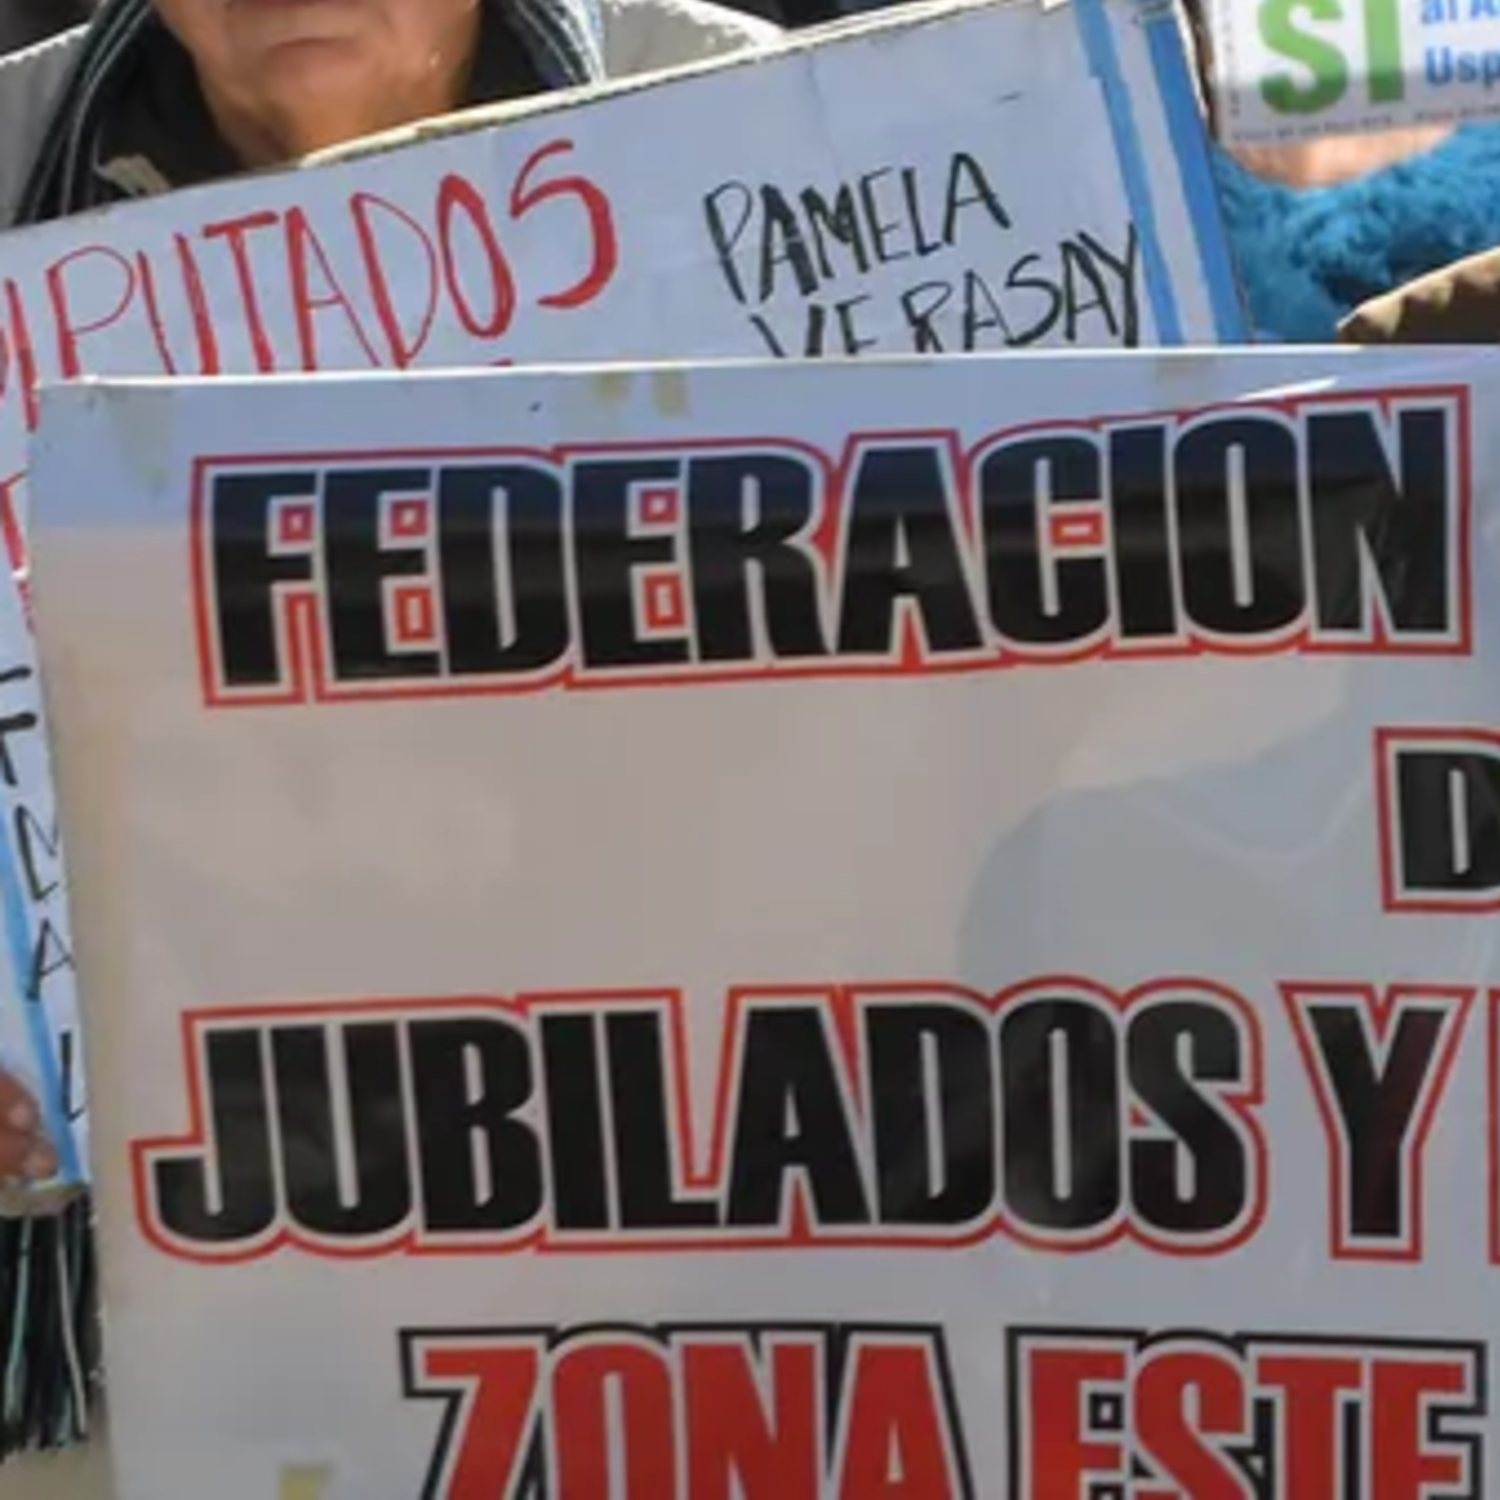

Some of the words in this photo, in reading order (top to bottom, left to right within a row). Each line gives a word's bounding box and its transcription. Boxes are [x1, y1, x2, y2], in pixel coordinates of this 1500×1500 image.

[0, 139, 617, 432] IPUTADOS
[704, 152, 1010, 304] PAMELA
[191, 384, 1471, 707] FEDERACION
[129, 976, 1270, 1264] JUBILADOS
[1278, 983, 1475, 1261] Y
[398, 1324, 980, 1500] ZONA
[1004, 1326, 1487, 1500] ESTE
